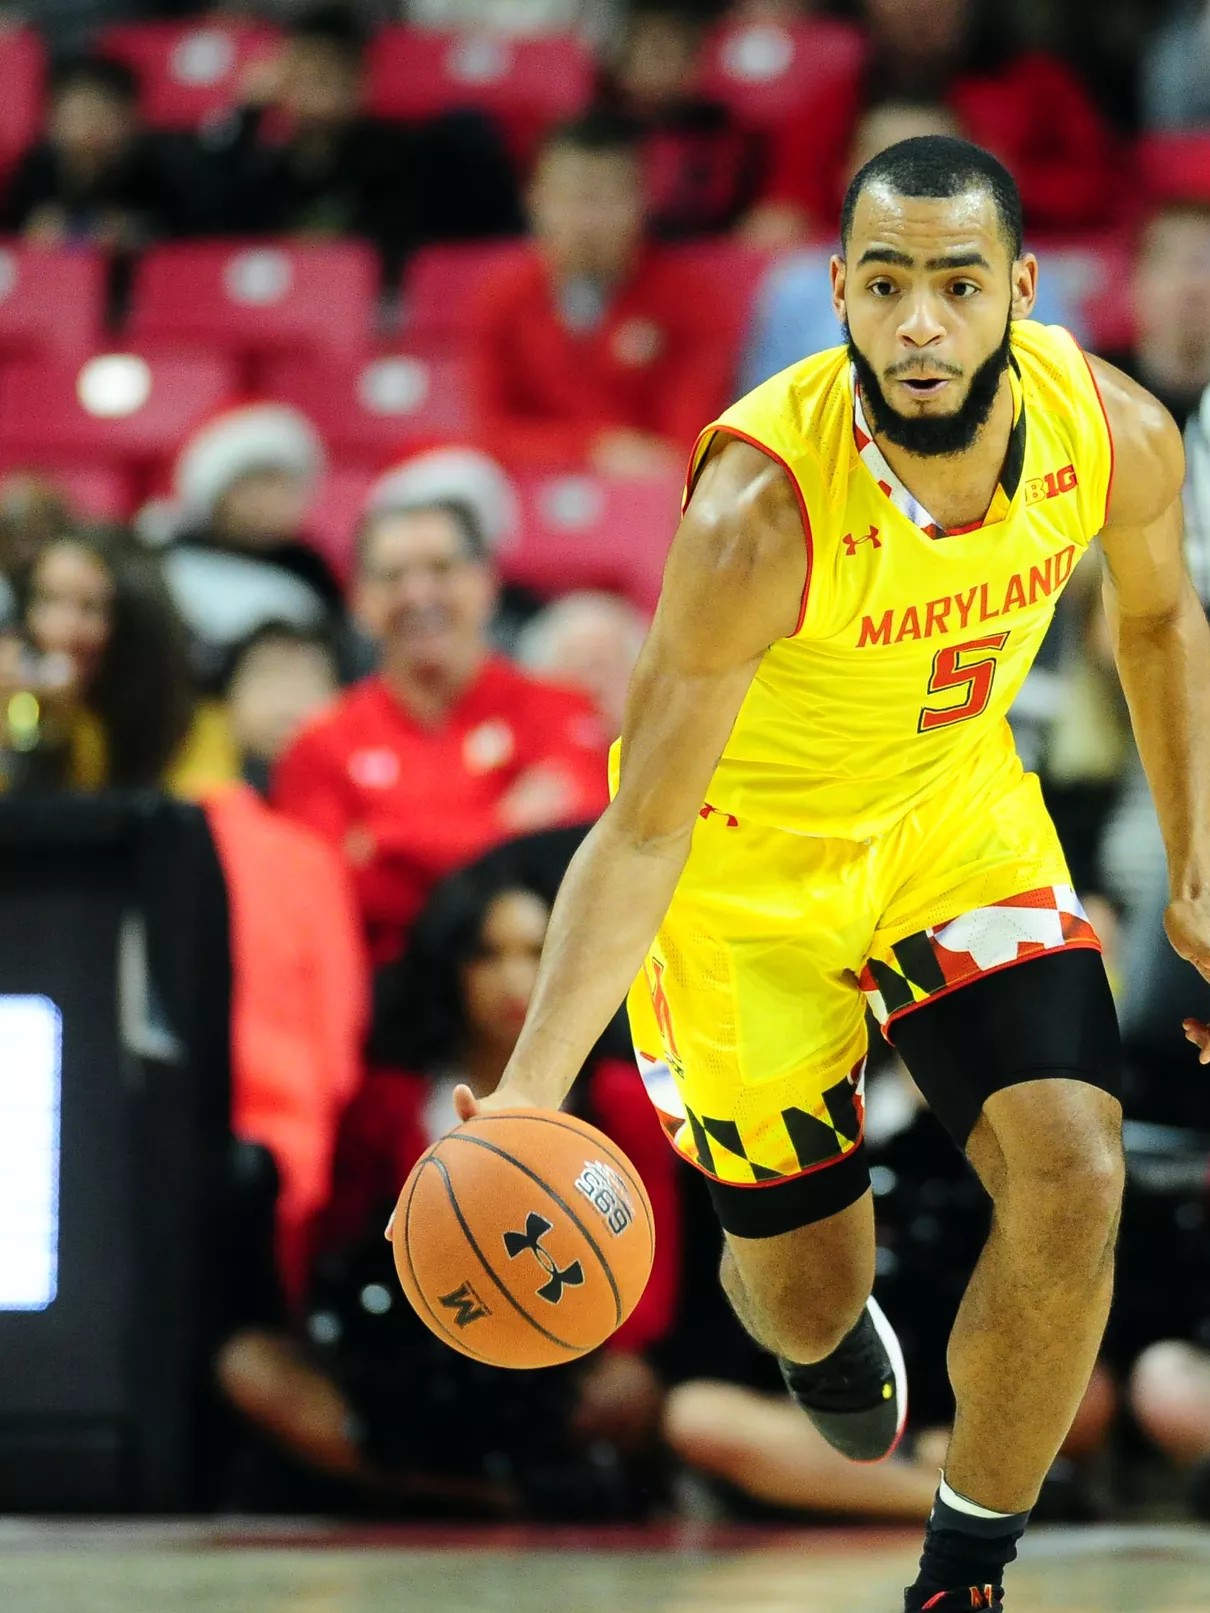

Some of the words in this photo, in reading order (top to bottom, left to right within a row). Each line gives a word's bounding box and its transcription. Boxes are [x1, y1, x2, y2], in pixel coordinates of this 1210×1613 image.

[855, 544, 1076, 649] MARYLAND
[917, 630, 1011, 734] 5
[575, 1168, 631, 1237] 695
[437, 1281, 489, 1330] M
